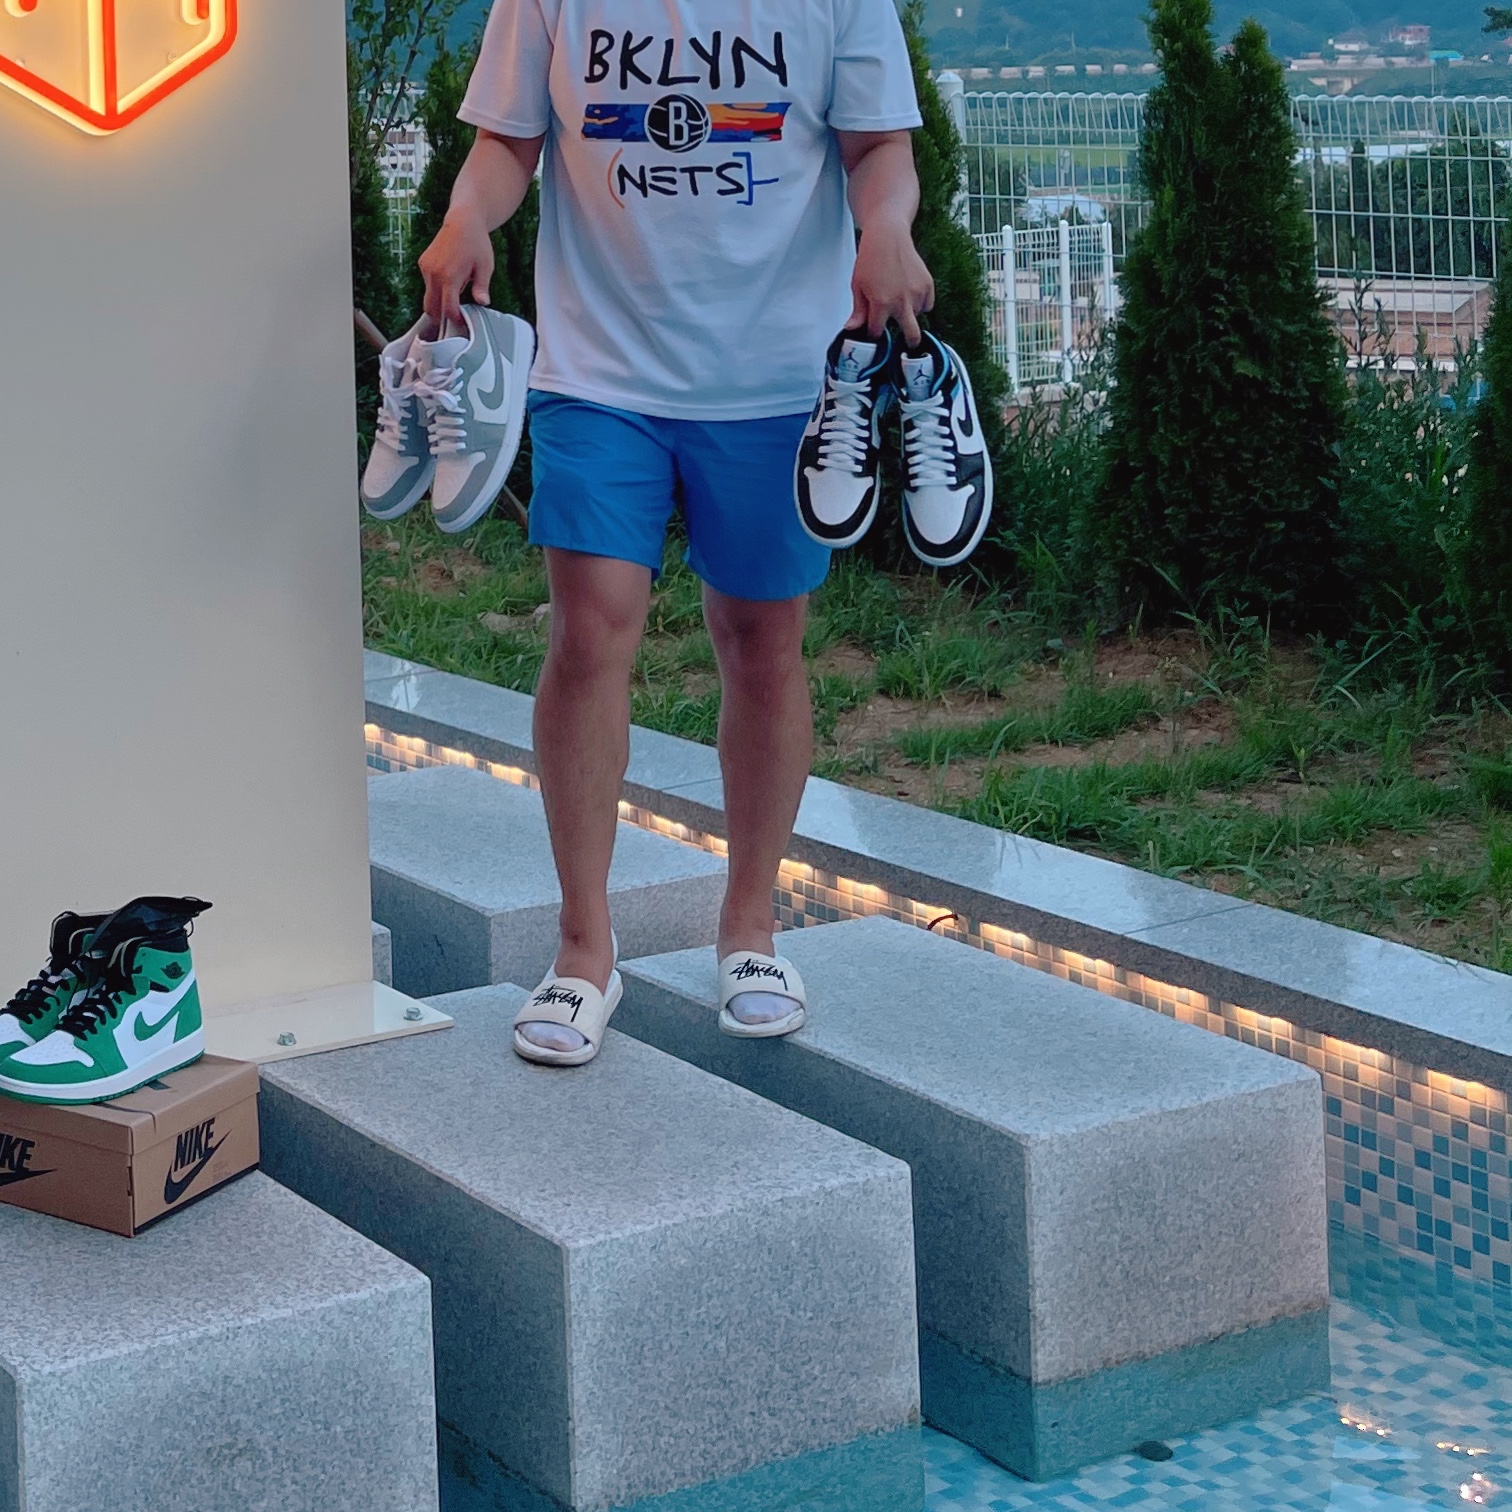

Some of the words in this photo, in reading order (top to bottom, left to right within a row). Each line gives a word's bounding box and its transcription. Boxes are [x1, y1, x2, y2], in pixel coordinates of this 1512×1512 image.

[584, 29, 788, 90] BKLYN
[668, 100, 689, 147] B
[174, 1117, 216, 1173] NIKE
